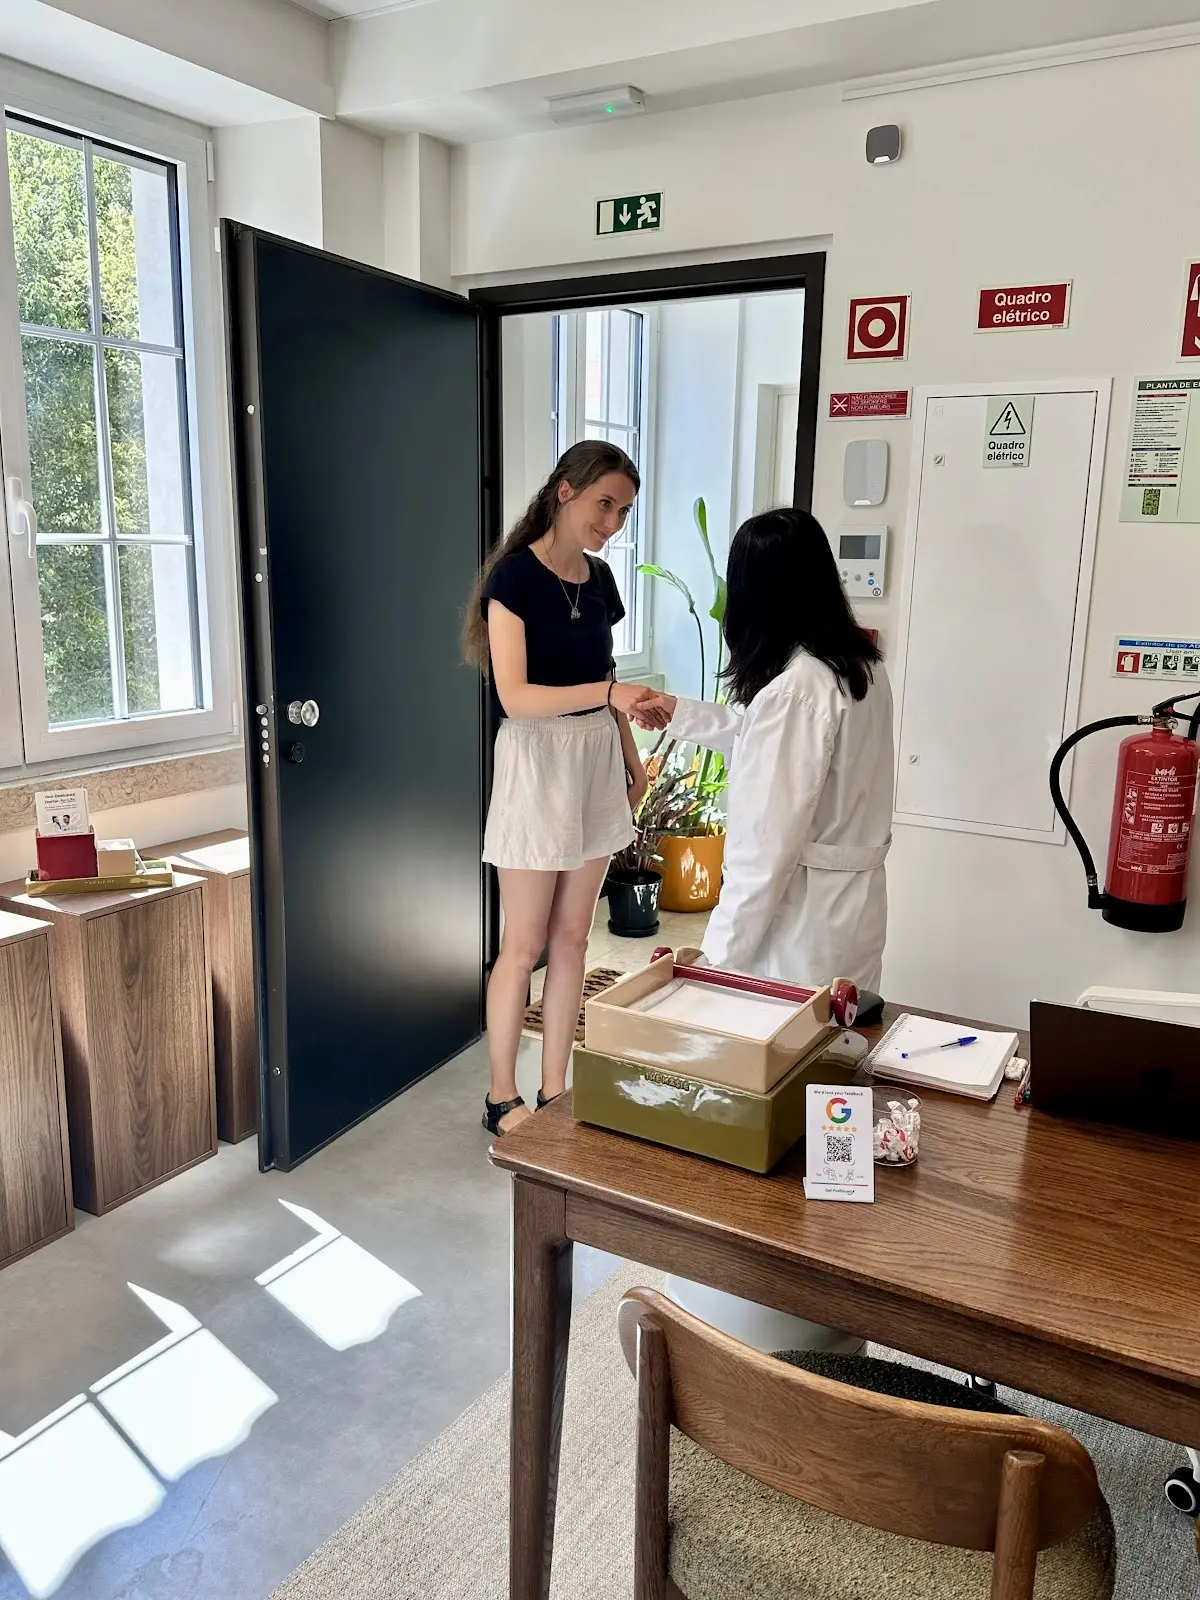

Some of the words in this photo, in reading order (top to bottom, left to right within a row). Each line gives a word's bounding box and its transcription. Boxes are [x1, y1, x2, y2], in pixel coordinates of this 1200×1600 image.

[994, 290, 1052, 306] Quadro
[992, 308, 1050, 324] elétrico
[988, 441, 1025, 450] Quadro
[987, 451, 1024, 461] elétrico
